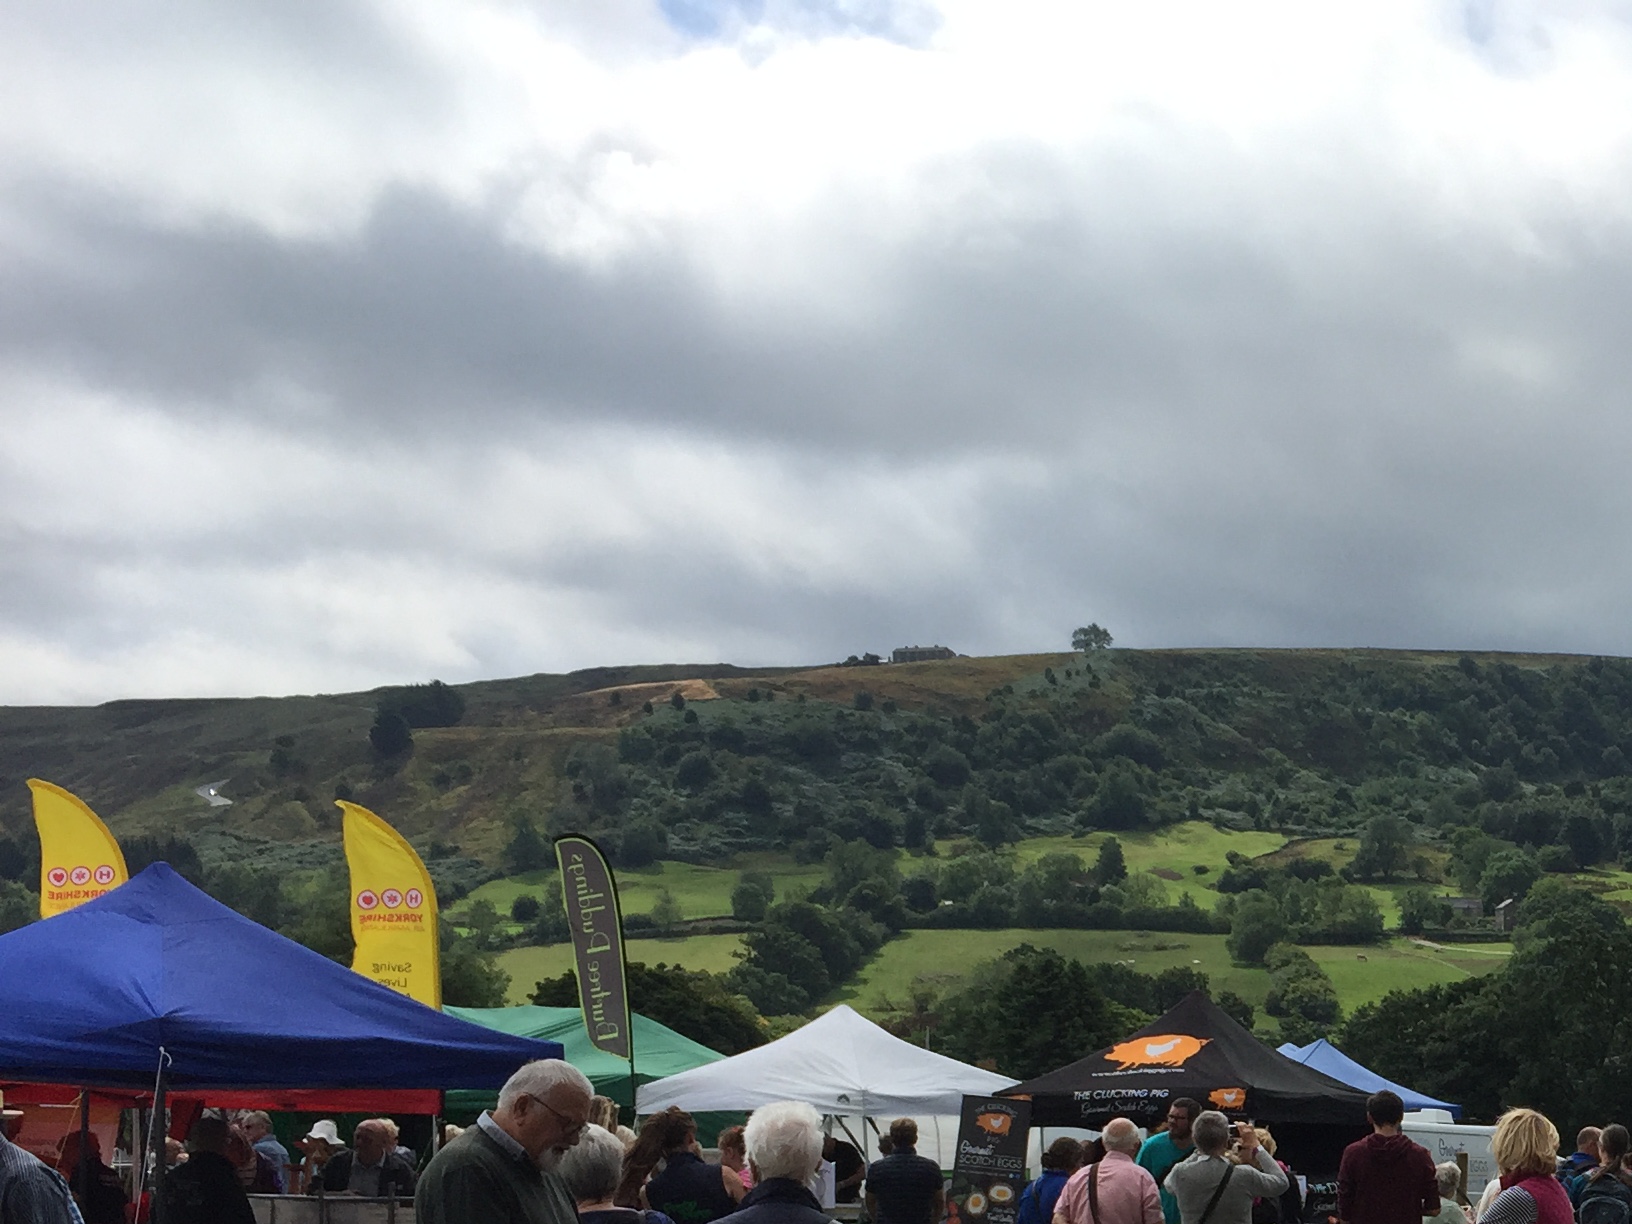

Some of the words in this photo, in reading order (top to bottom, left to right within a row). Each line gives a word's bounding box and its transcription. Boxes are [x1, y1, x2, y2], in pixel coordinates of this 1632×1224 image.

[1073, 1090, 1091, 1100] THE
[1093, 1089, 1149, 1100] CLUCKING
[1150, 1088, 1169, 1099] PIG
[959, 1154, 995, 1166] SCOTCH
[997, 1158, 1022, 1169] EGGS
